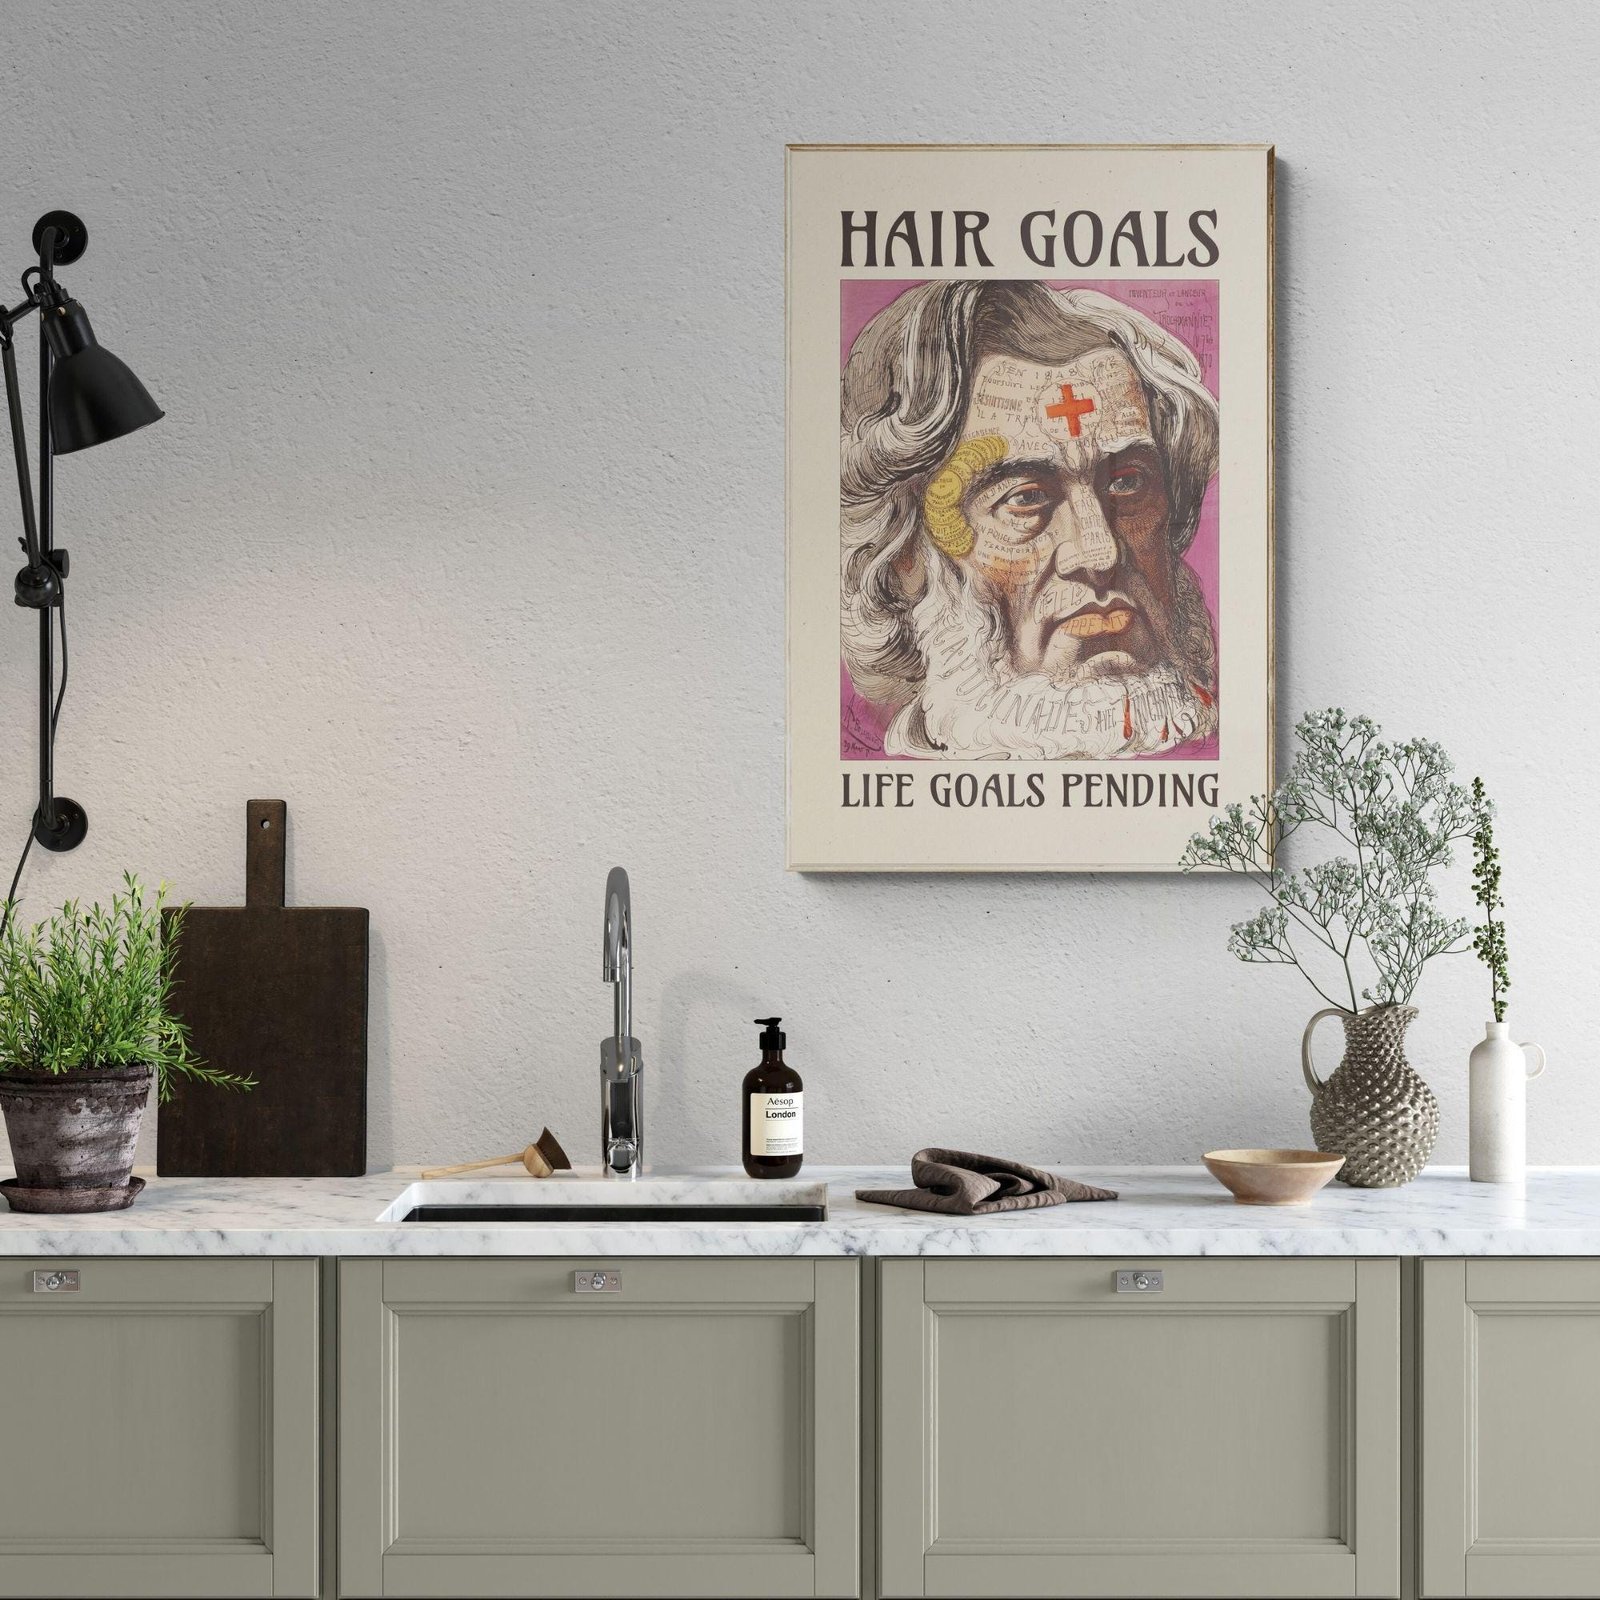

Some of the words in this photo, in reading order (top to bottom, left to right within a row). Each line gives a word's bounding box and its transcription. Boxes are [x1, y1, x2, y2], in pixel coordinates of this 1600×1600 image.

[841, 211, 994, 267] HAIR
[1021, 209, 1219, 267] GOALS
[1018, 439, 1049, 451] AVEC
[842, 774, 913, 807] LIFE
[931, 773, 1044, 807] GOALS
[1062, 774, 1218, 807] PENDING
[765, 1110, 796, 1118] London
